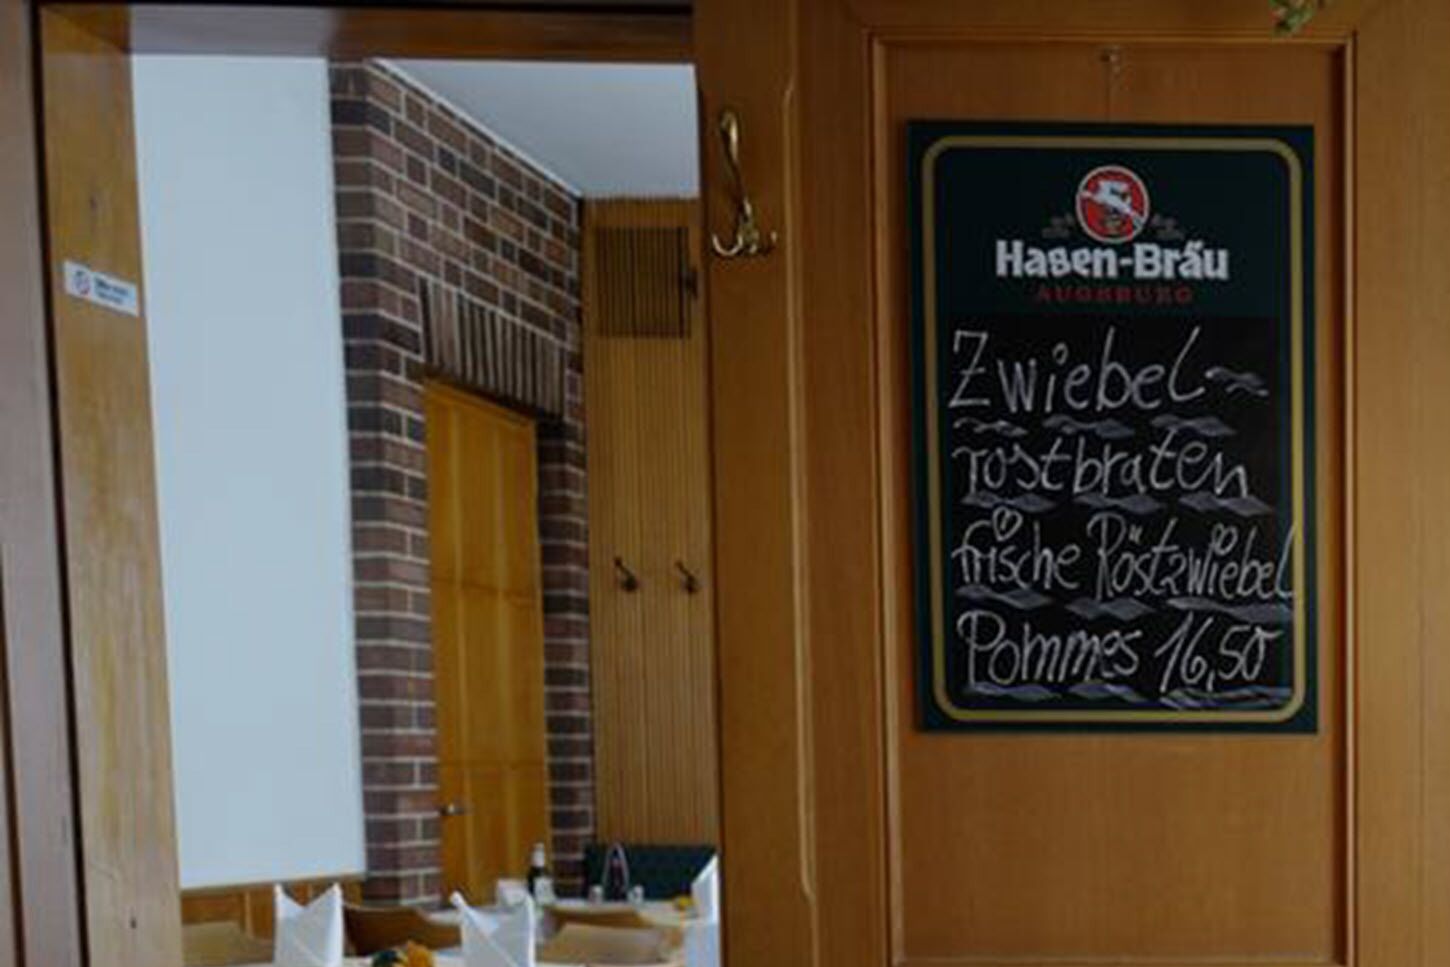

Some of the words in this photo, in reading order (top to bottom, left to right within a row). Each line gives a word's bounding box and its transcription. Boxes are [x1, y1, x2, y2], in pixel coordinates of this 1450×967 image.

[995, 239, 1230, 281] Hasen-Bräu
[951, 508, 1081, 590] frische
[956, 609, 1142, 685] Pommes
[1153, 611, 1283, 692] 16,50
